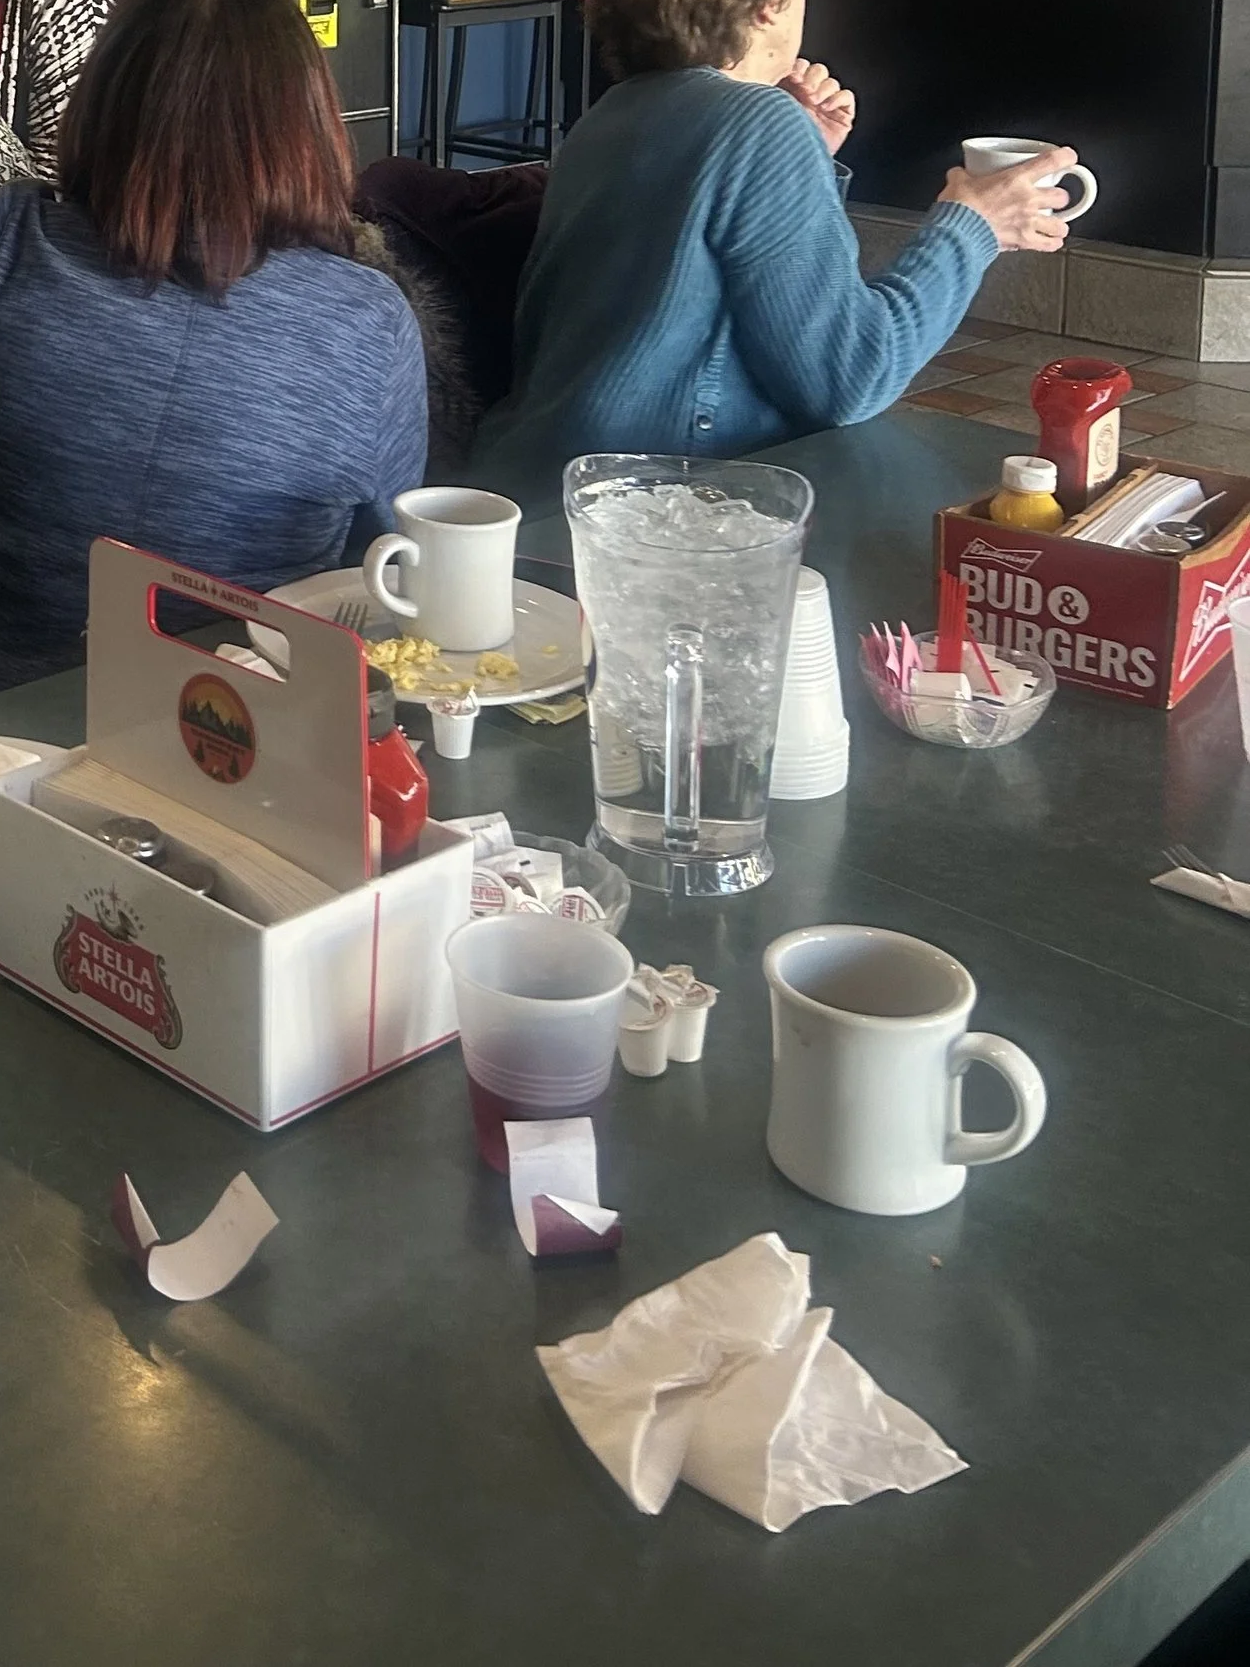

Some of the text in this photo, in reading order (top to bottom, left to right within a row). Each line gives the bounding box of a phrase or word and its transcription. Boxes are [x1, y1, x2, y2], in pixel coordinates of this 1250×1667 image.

[171, 571, 259, 612] STELLA ARTOIS
[959, 562, 1043, 616] BUD
[966, 607, 1157, 688] BURGERS
[78, 931, 155, 992] STELLA
[78, 957, 156, 1016] ARTOIS
